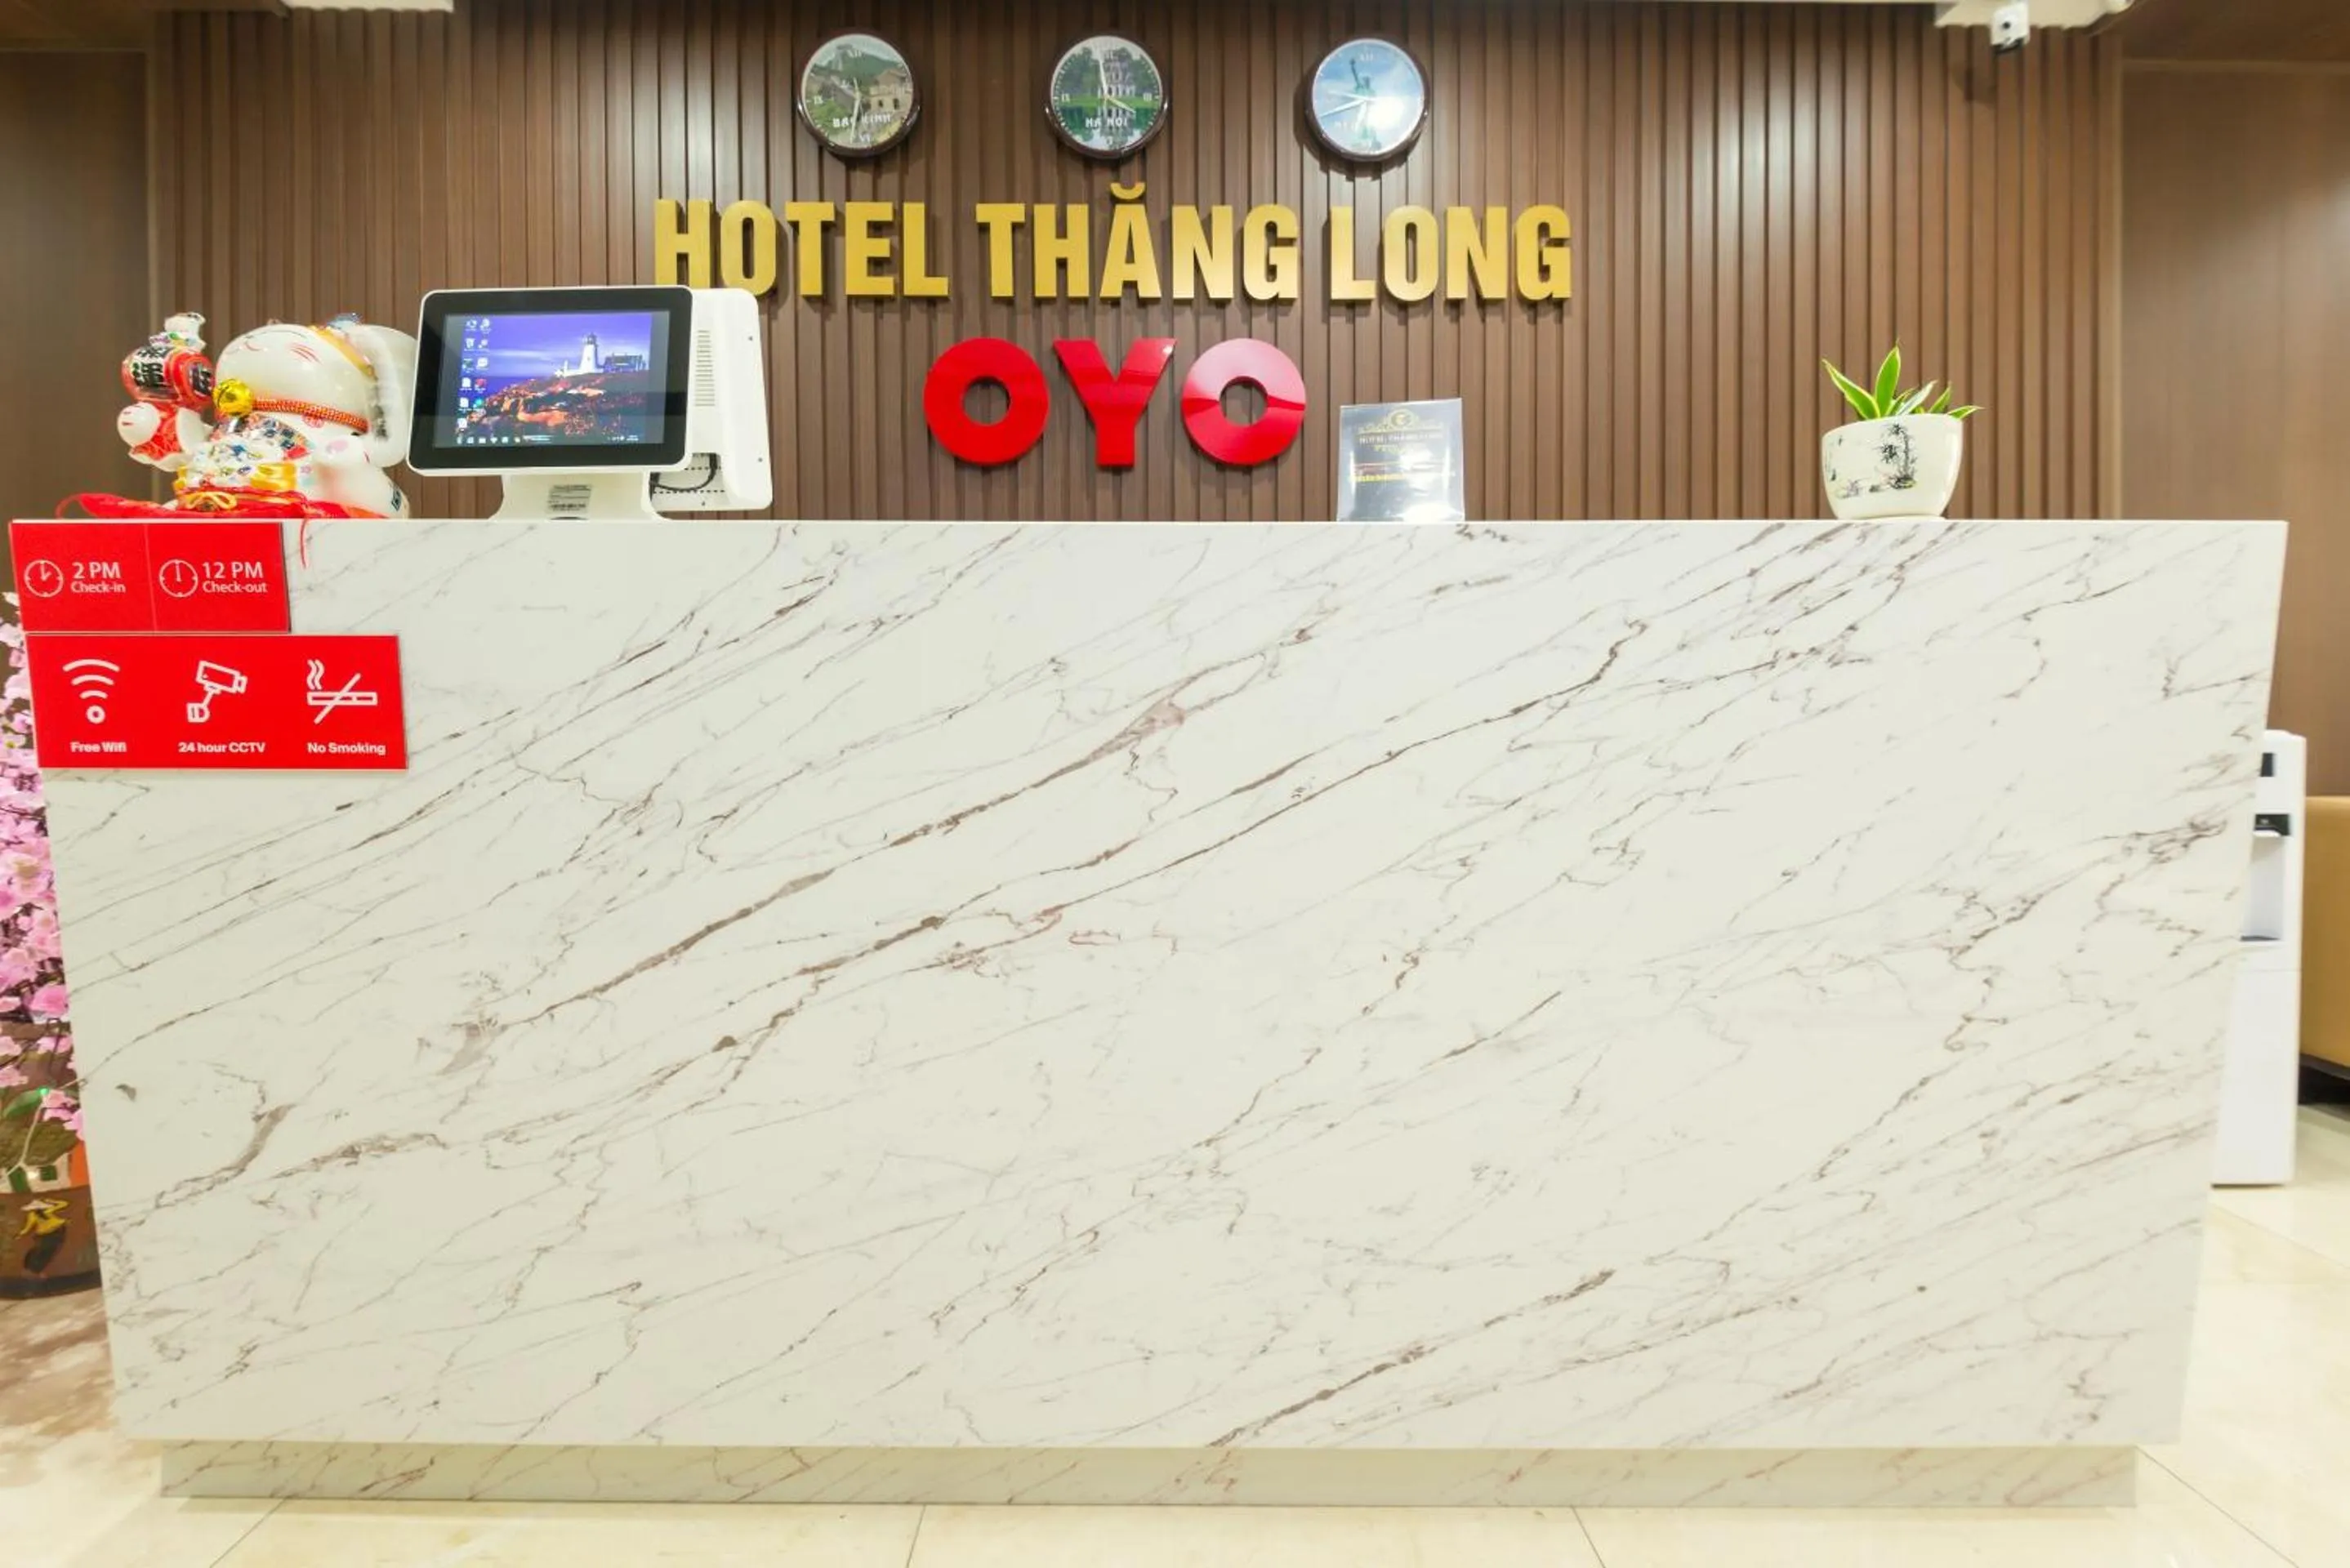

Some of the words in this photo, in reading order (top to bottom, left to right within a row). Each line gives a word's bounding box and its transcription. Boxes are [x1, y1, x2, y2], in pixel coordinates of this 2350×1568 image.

[655, 199, 950, 299] HOTEL
[976, 182, 1300, 302] THĂNG
[1330, 204, 1572, 303] LONG
[924, 337, 1306, 468] OYO
[72, 562, 85, 579] 2
[89, 562, 122, 579] PM
[203, 561, 226, 579] 12
[231, 561, 264, 579] PM
[70, 580, 127, 594] Check-in
[203, 580, 269, 594] Check-out
[70, 742, 99, 753] Free
[101, 742, 127, 753] Wifi
[178, 742, 196, 753] 24
[197, 742, 227, 753] hour
[229, 742, 266, 753] CCTV
[307, 742, 327, 754] No
[328, 742, 386, 756] Smoking
